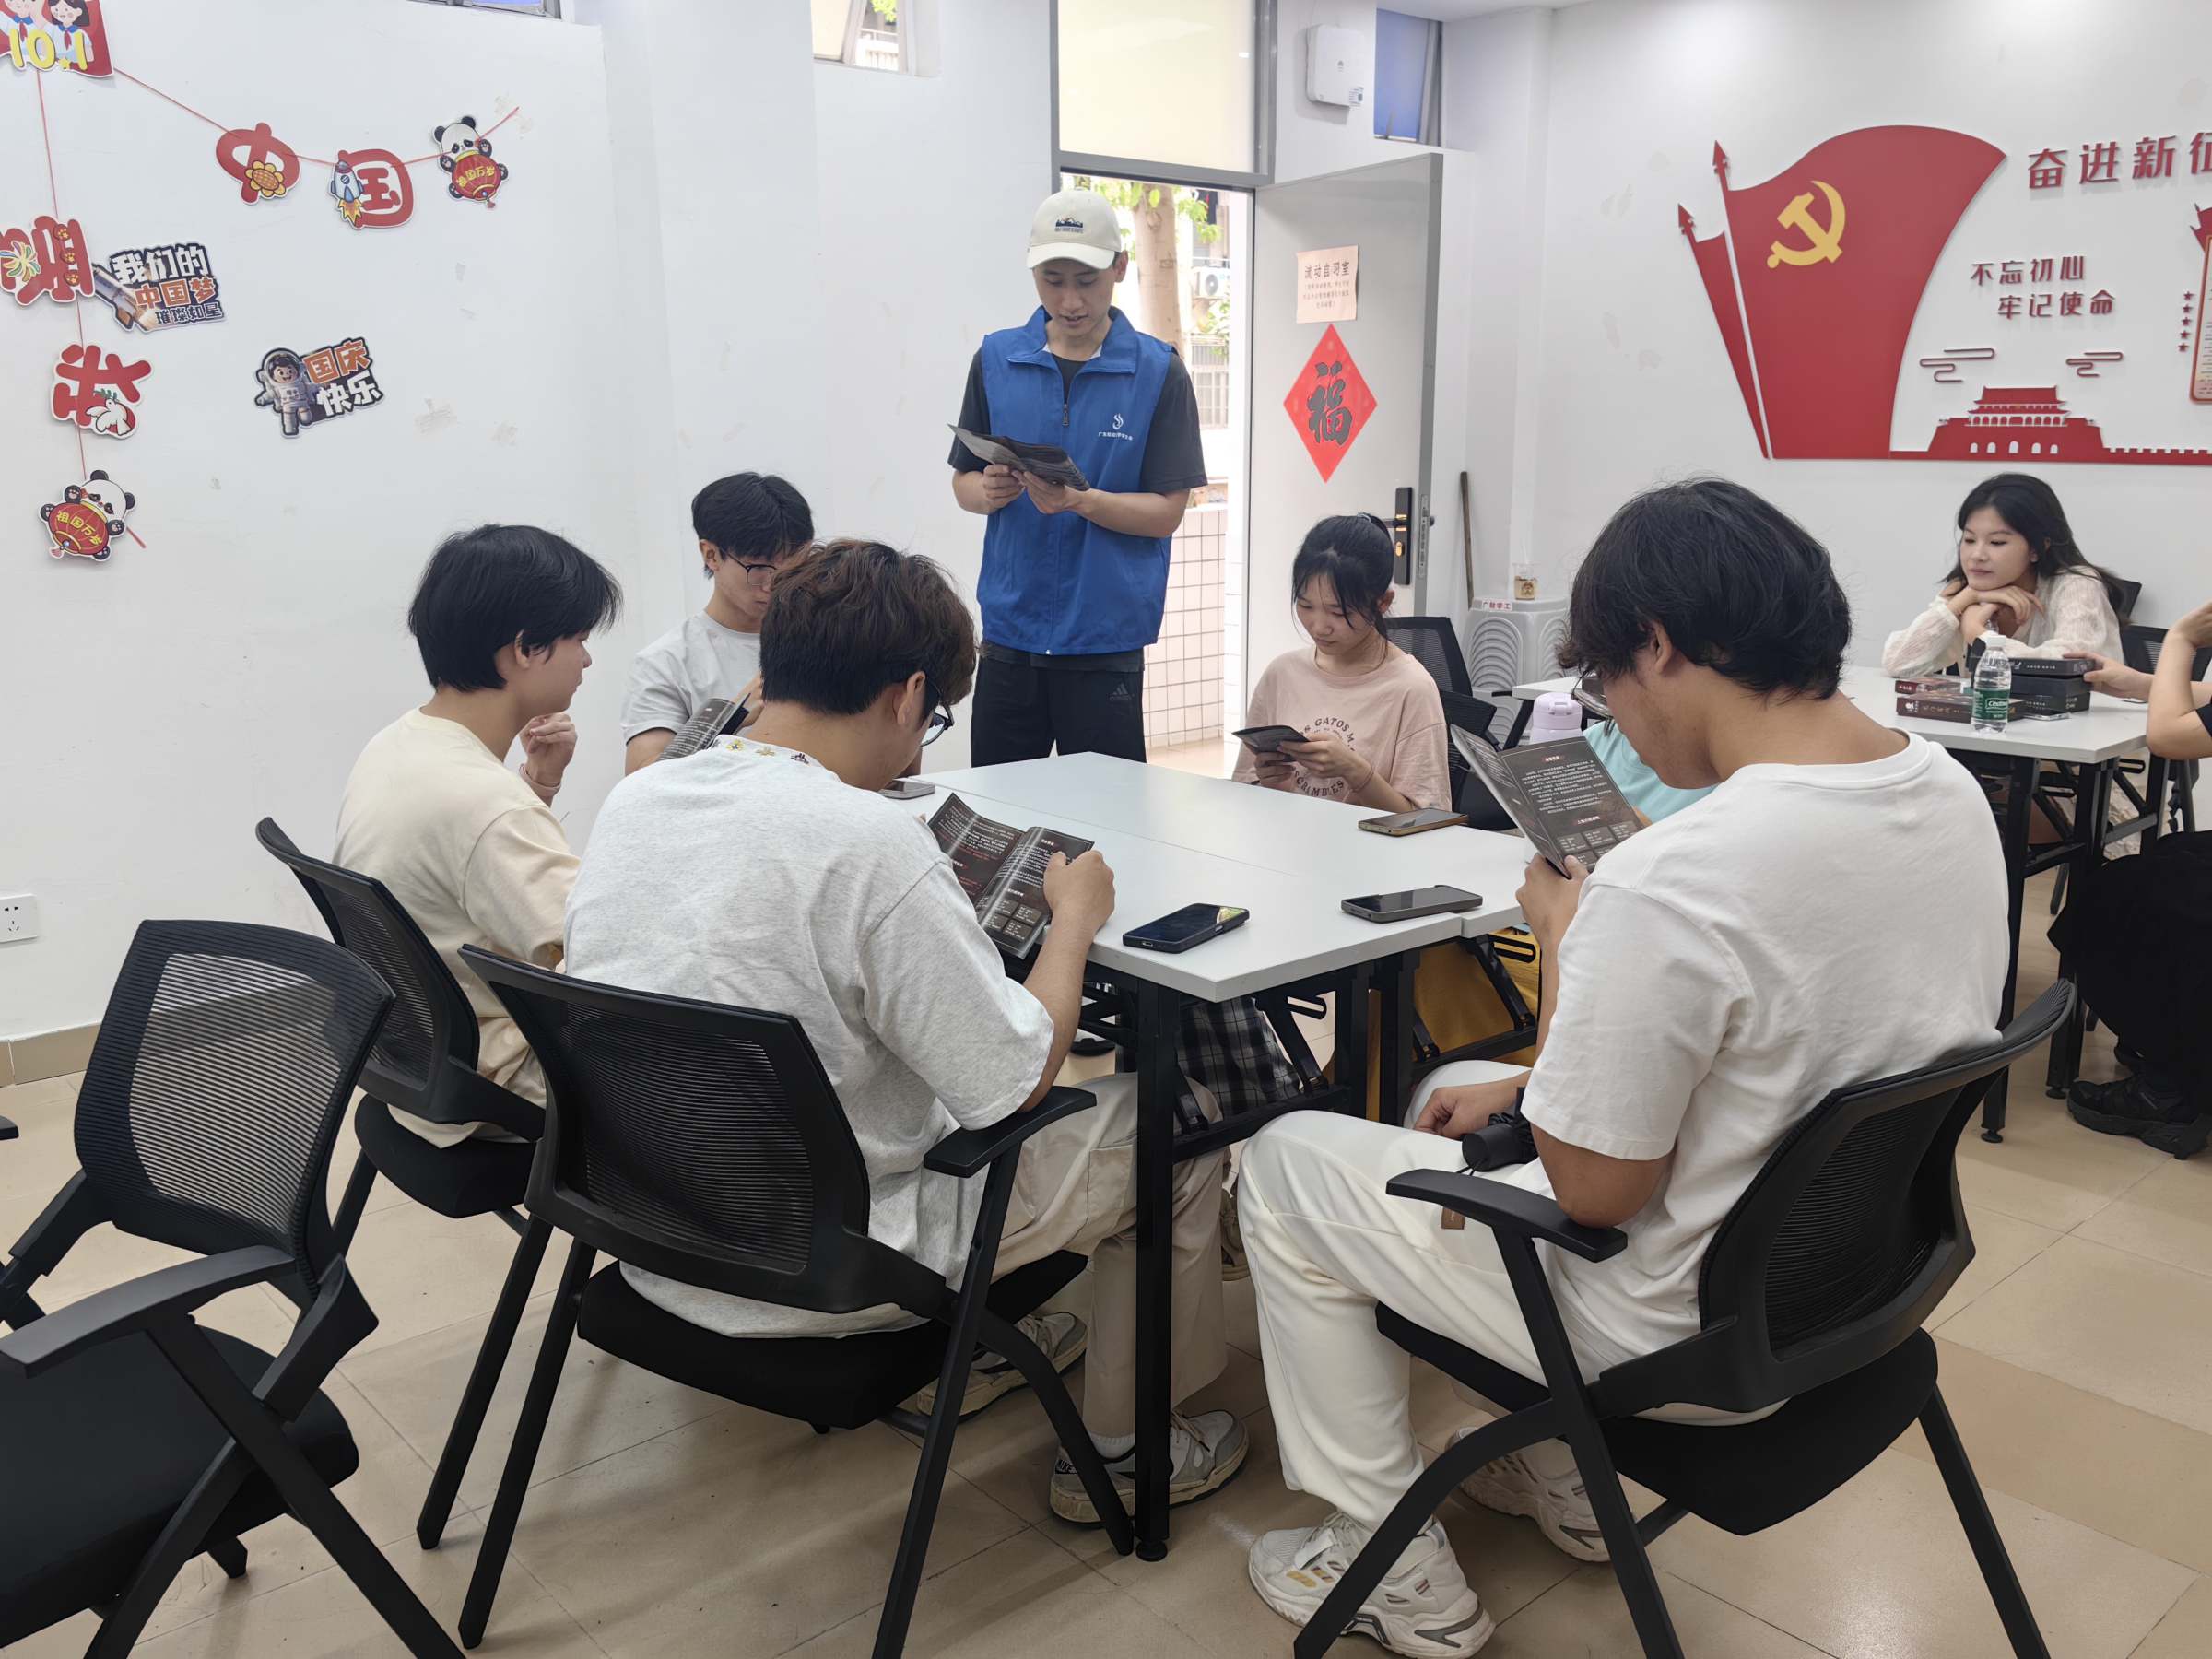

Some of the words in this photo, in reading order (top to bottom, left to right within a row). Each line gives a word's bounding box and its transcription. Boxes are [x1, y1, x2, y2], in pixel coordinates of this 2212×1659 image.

[112, 245, 209, 285] 我们的
[1971, 255, 2085, 287] 不忘初心
[135, 277, 217, 309] 中国梦
[1997, 289, 2116, 320] 牢记使命
[302, 340, 371, 384] 国庆
[316, 369, 382, 417] 快乐
[1314, 717, 1350, 733] GATOS
